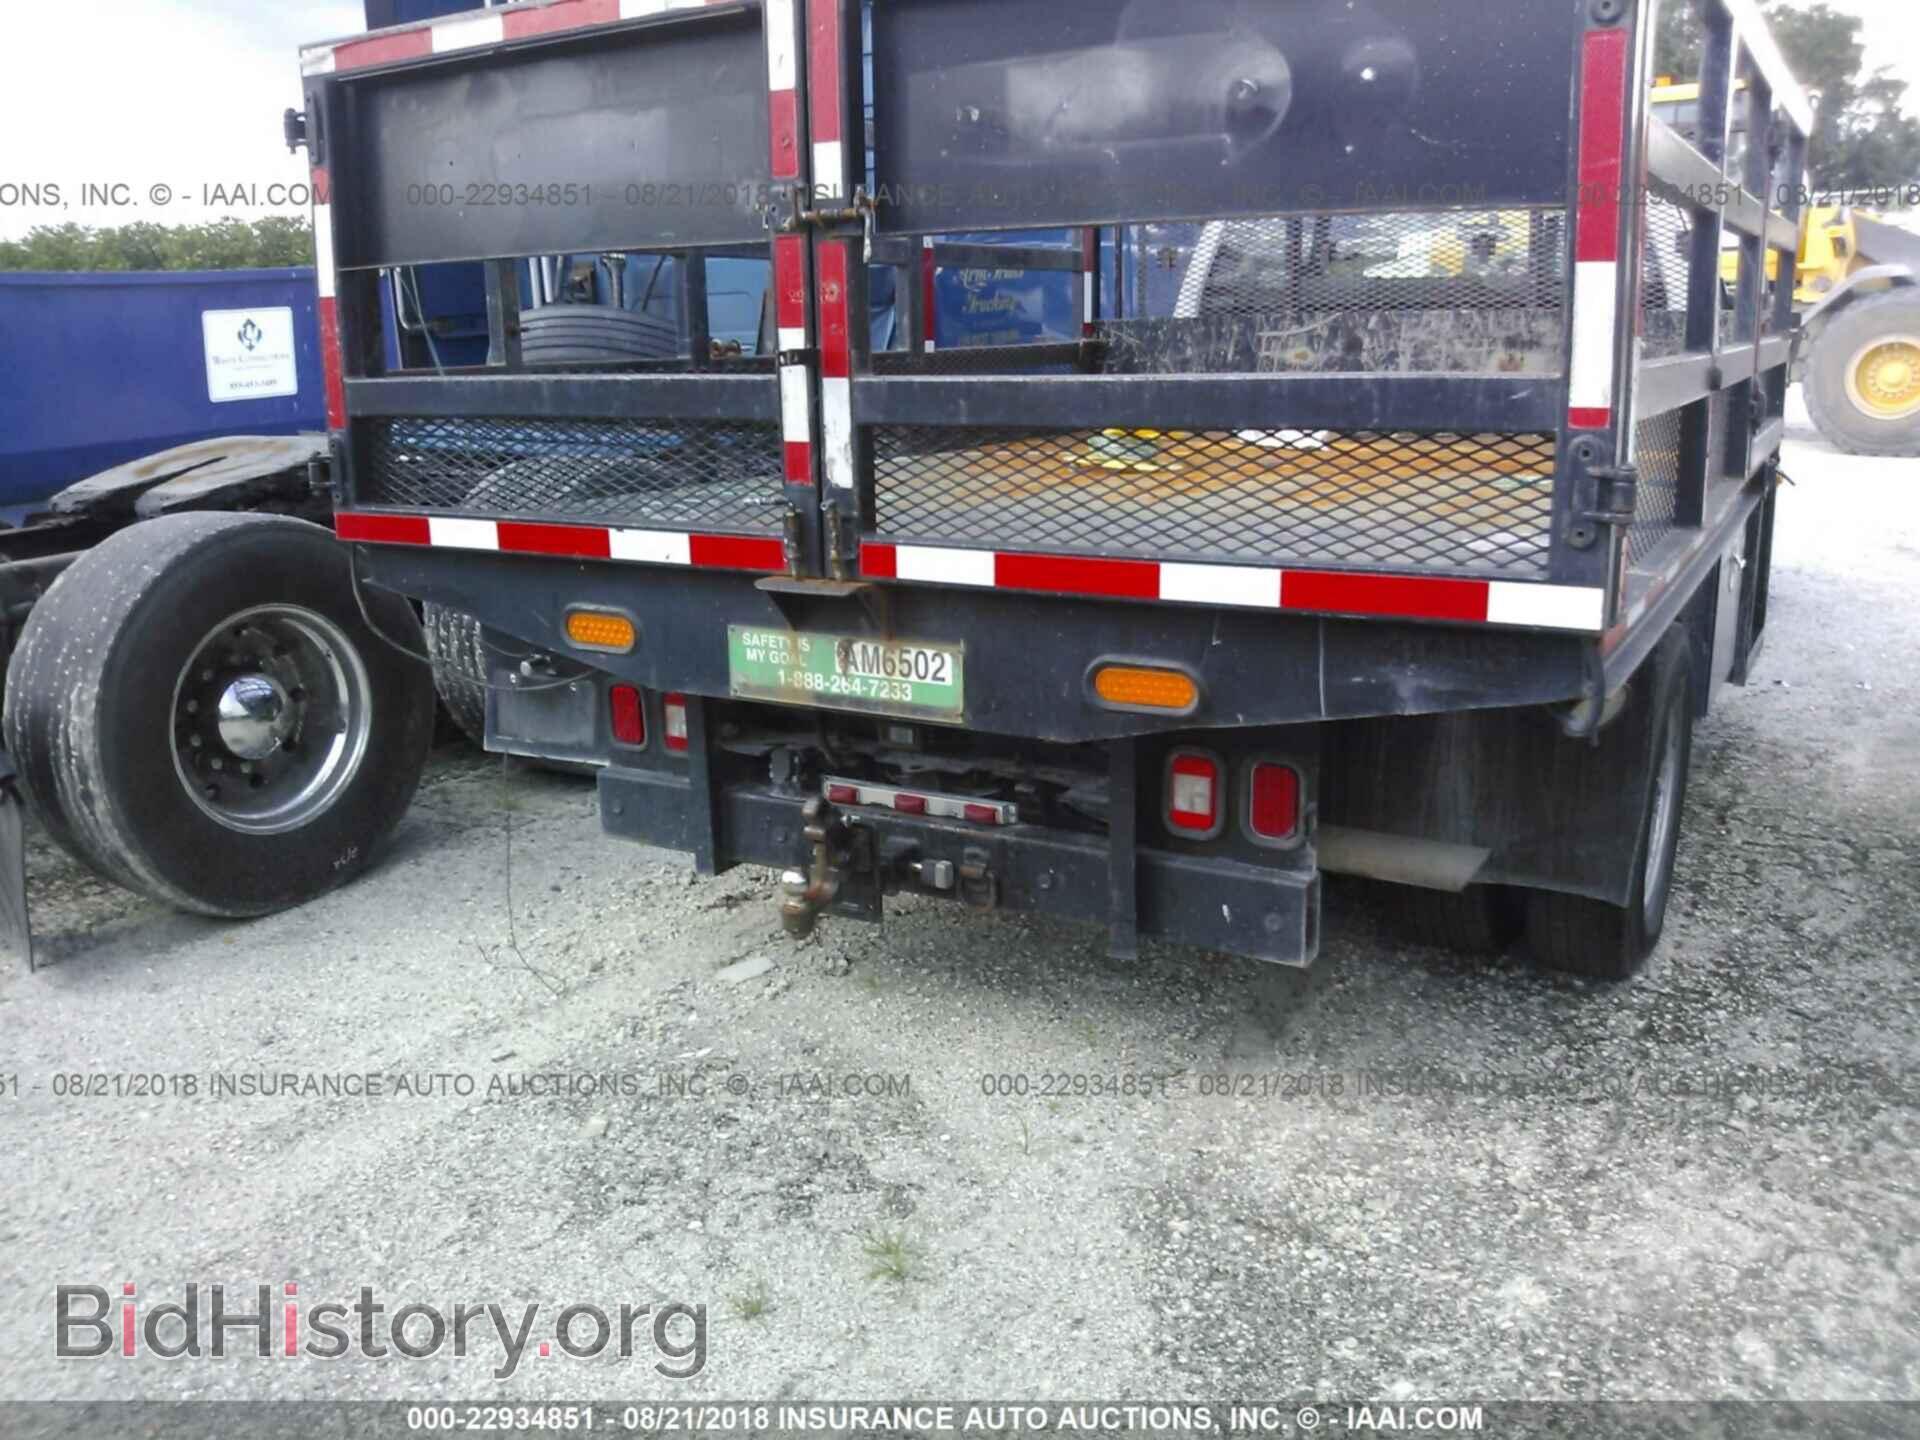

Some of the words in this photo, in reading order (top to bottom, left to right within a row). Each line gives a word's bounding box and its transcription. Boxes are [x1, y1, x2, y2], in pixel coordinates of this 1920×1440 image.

[746, 648, 766, 663] MY
[845, 643, 946, 682] AM6502
[777, 668, 913, 702] 1-888-264-7233
